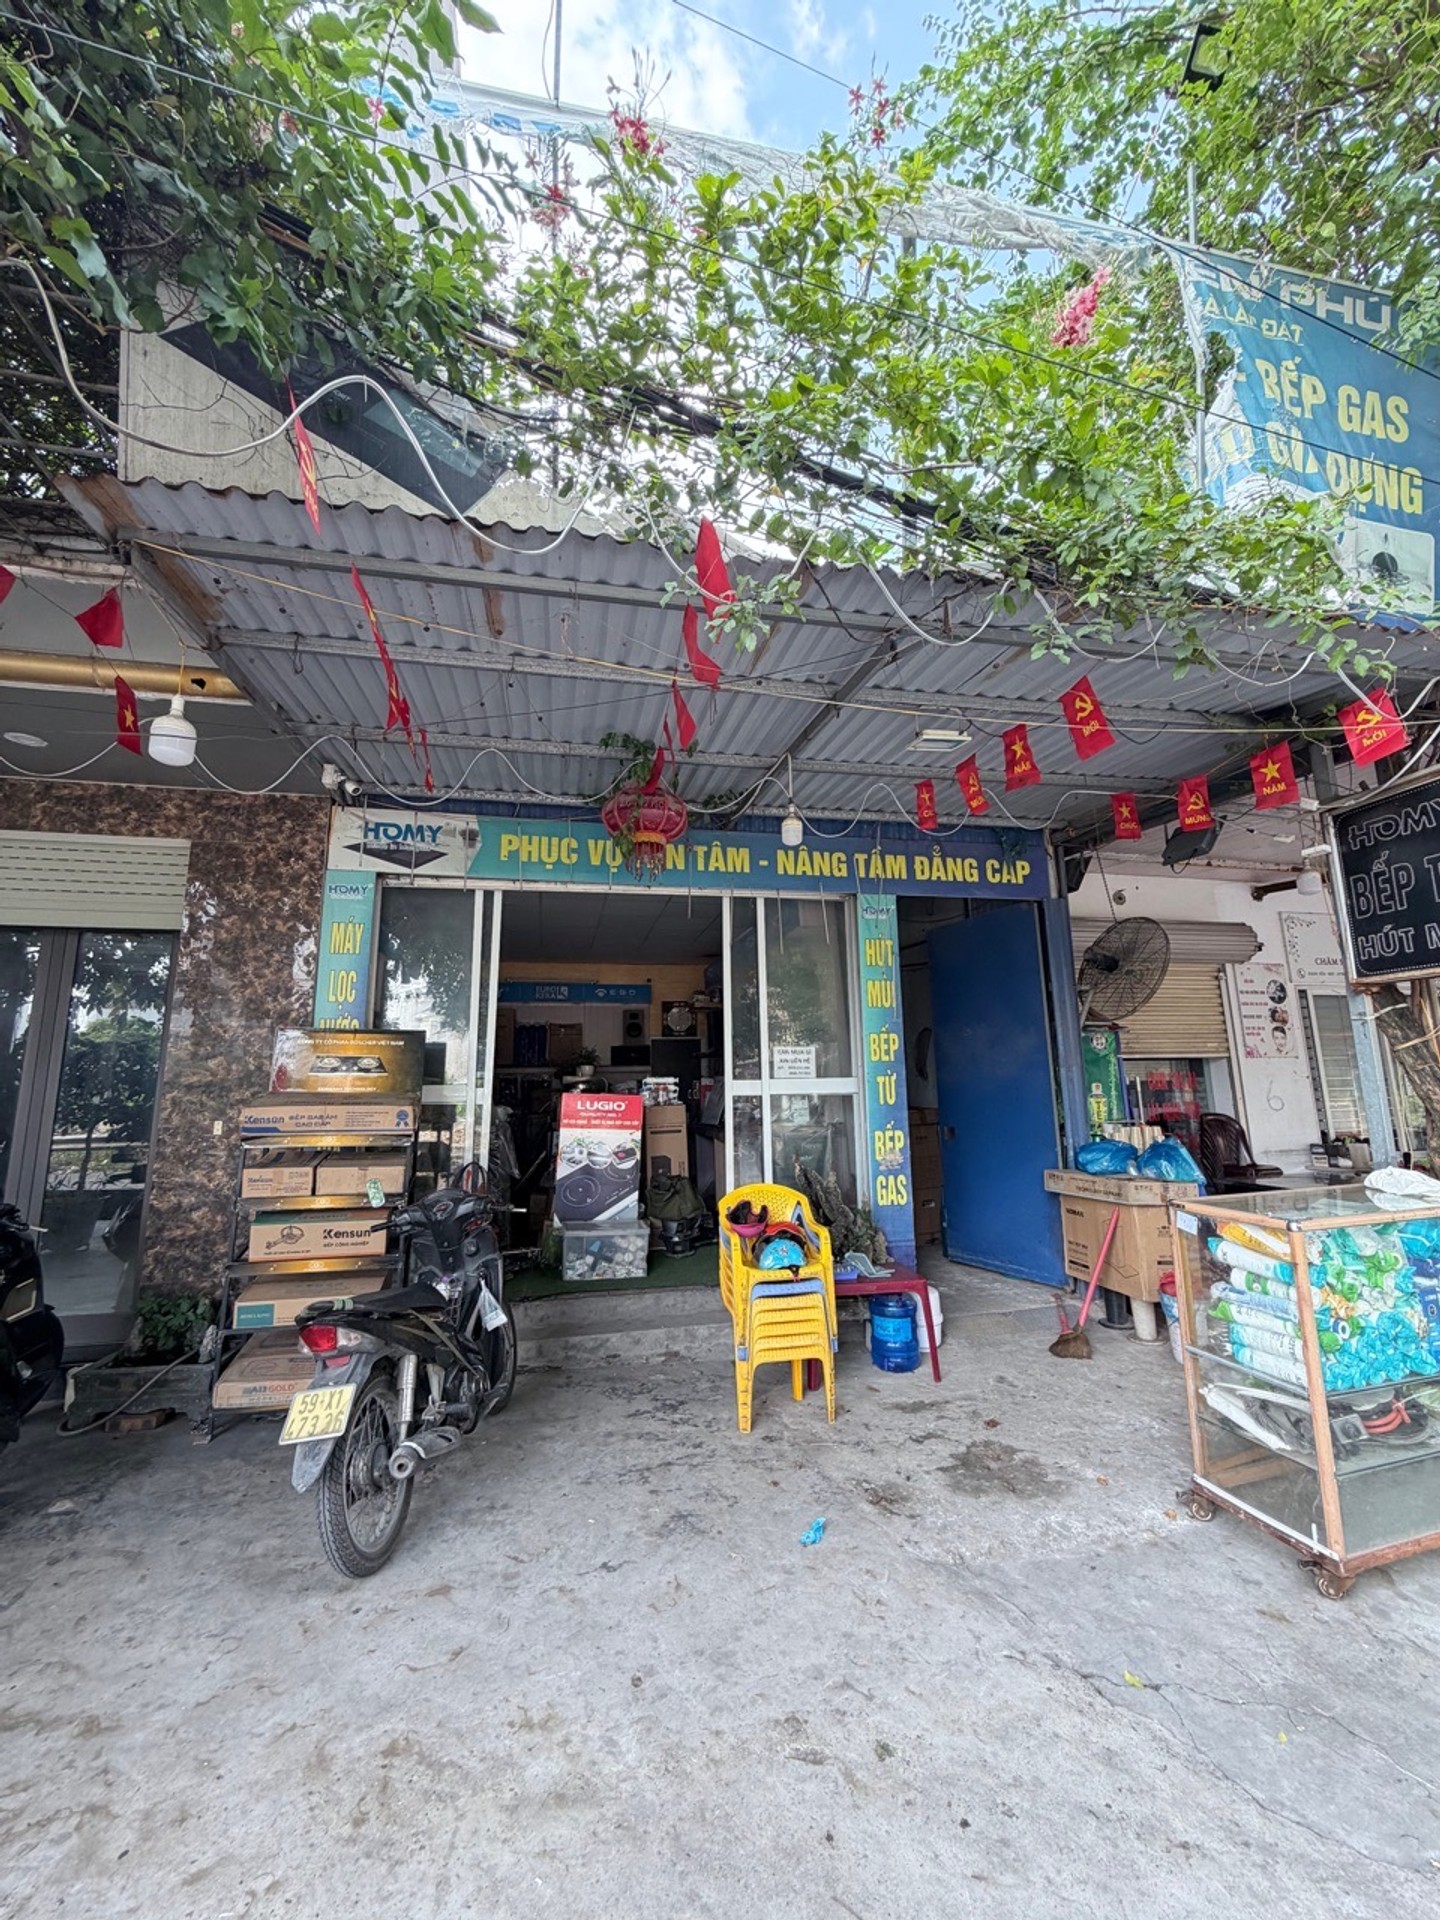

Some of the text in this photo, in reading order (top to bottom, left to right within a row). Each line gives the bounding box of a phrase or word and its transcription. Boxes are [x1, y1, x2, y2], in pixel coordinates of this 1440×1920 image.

[1255, 356, 1327, 419] BẾP
[1338, 384, 1410, 443] GAS
[1361, 729, 1387, 747] MỚI
[363, 821, 444, 843] HOMY
[1349, 799, 1440, 851] HOM
[500, 833, 579, 870] PHỤC
[587, 838, 624, 873] VỤ
[694, 841, 751, 874] TÂM
[776, 845, 848, 878] NÂNG
[328, 884, 369, 896] HOMY
[1350, 850, 1416, 919] BẾP
[330, 915, 365, 955] MÁY
[865, 932, 894, 967] HÚT
[1357, 922, 1416, 961] HÚT
[328, 970, 358, 1011] LỌC
[867, 972, 896, 1008] MÙI
[869, 1023, 899, 1062] BẾP
[876, 1069, 897, 1105] TỪ
[577, 1100, 626, 1112] LUGIO
[876, 1173, 908, 1206] GAS
[323, 1228, 371, 1239] Kensun
[268, 1384, 295, 1393] GOLD
[298, 1390, 344, 1415] 59-X1
